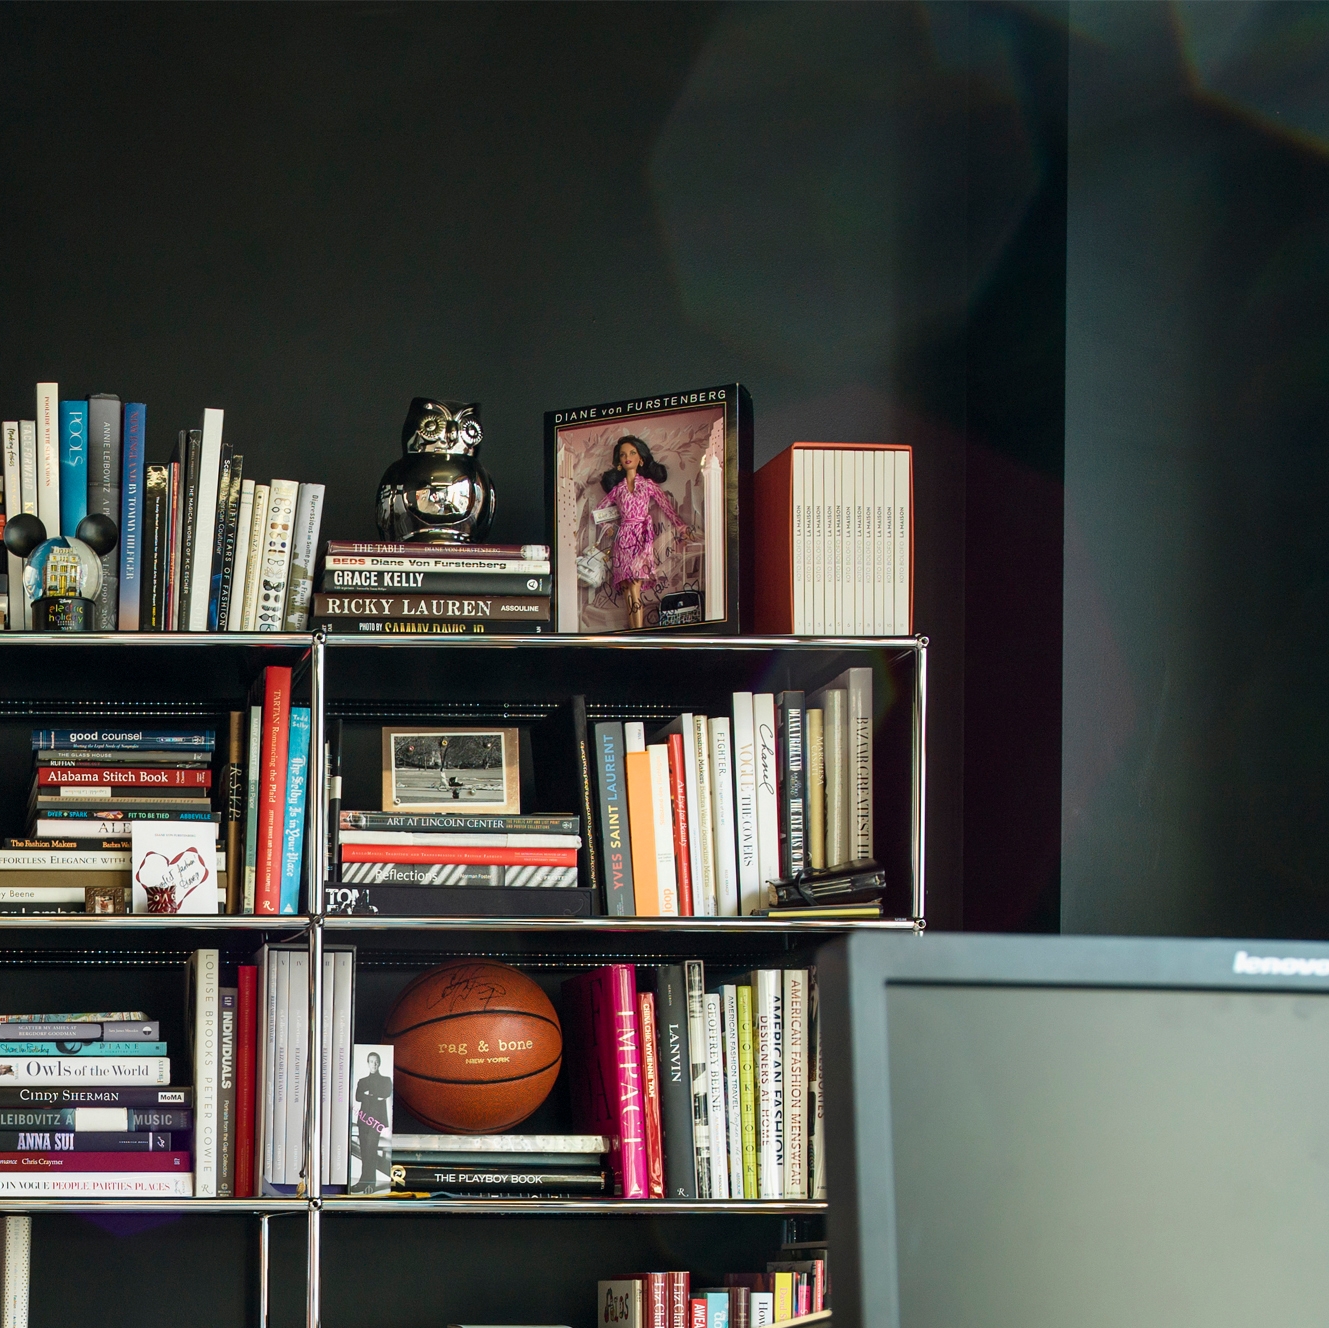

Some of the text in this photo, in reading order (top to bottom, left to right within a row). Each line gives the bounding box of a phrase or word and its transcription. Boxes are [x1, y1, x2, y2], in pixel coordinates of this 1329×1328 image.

[554, 389, 727, 423] DIANE von FURSTENBERG
[68, 411, 83, 467] POOLS
[102, 421, 111, 493] ANNIE LEIBOVITZ
[352, 543, 405, 553] THE TABLE
[370, 558, 404, 566] Diane
[408, 559, 430, 567] Von
[434, 560, 507, 570] Furstenberg
[334, 571, 424, 587] GRACE KELLY
[326, 598, 492, 616] RICKY LAUREN
[69, 731, 142, 743] good counsel
[758, 723, 775, 795] Chanel
[47, 770, 169, 783] Alabama Stitch Book
[602, 734, 625, 890] YVES SAINT LAURENT
[739, 743, 754, 868] VOGUE THE COVERS
[386, 817, 504, 829] ART AT LINCOLN CENTER
[375, 869, 438, 882] Reflections
[9, 889, 35, 899] Beene
[221, 1011, 233, 1089] INDIVIDUALS
[438, 1039, 534, 1055] rag & bone
[669, 1023, 682, 1083] LANVIN
[26, 1060, 150, 1078] Owls of the World
[616, 1010, 644, 1151] IMPACT
[17, 1132, 75, 1150] ANNA SUI
[434, 1173, 543, 1184] THE PLAYBOY BOOK
